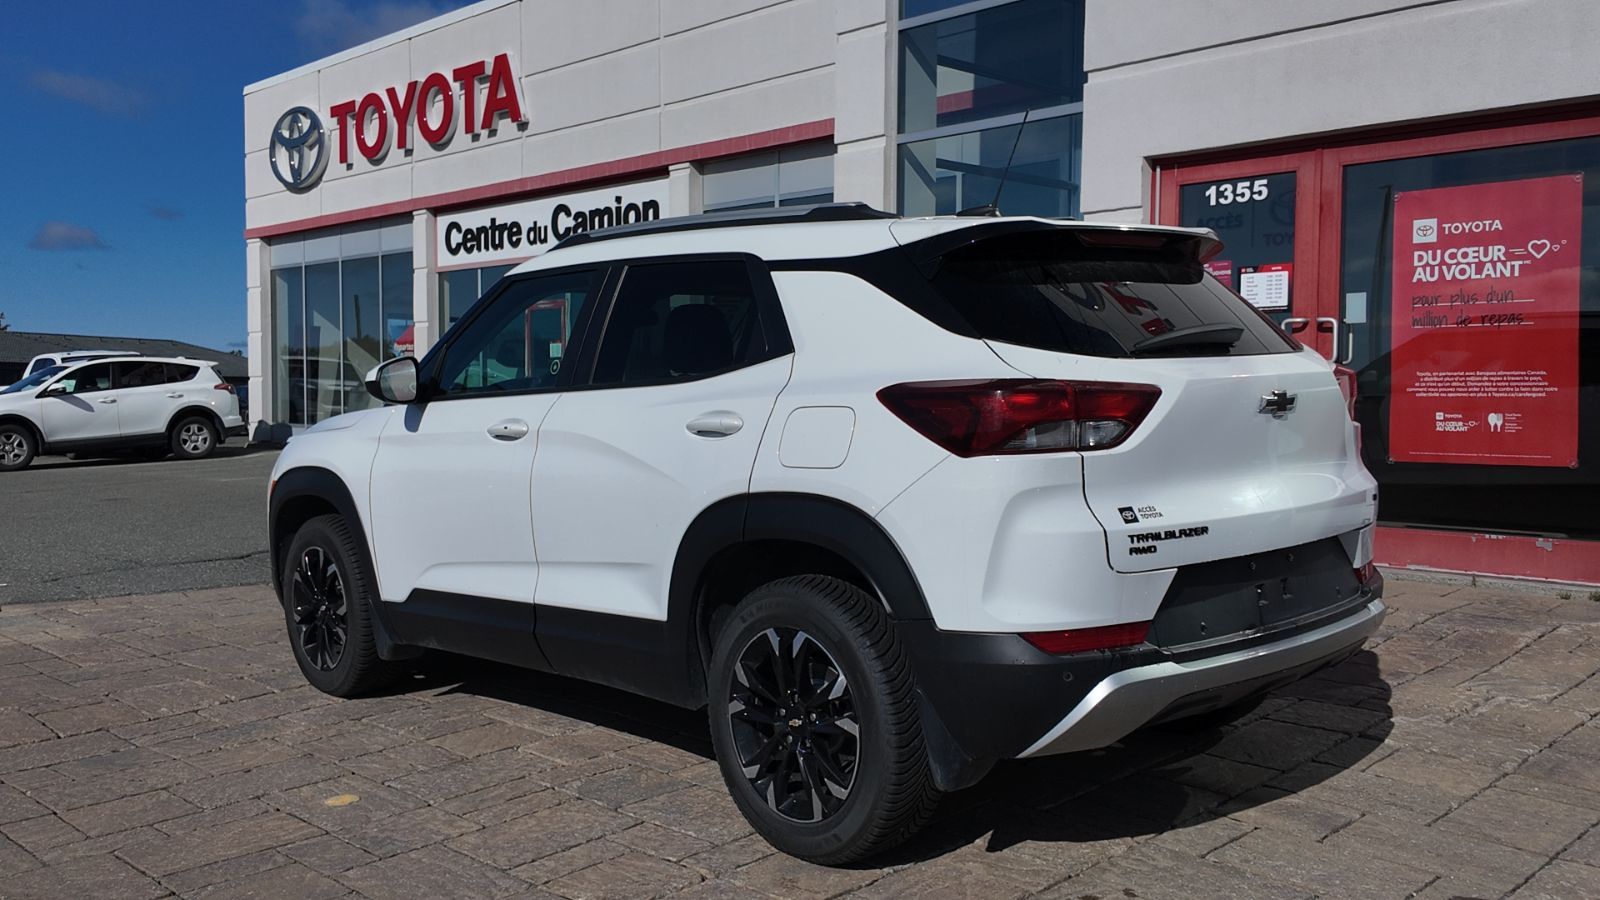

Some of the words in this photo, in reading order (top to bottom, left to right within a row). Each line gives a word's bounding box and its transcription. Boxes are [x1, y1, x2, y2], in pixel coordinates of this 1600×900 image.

[330, 53, 524, 165] TOYOTA
[1205, 179, 1268, 206] 1355
[445, 217, 522, 256] Centre
[527, 220, 548, 246] du
[551, 196, 660, 242] Camion
[1442, 220, 1503, 235] TOYOTA
[1413, 249, 1441, 267] DU
[1444, 245, 1506, 264] CŒUR
[1412, 265, 1441, 283] AU
[1441, 260, 1523, 281] VOLANT
[1412, 295, 1441, 311] pour
[1450, 288, 1478, 309] plus
[1486, 285, 1514, 304] d'un
[1412, 310, 1448, 327] million
[1455, 309, 1472, 326] de
[1480, 312, 1525, 329] repas
[1140, 511, 1163, 519] TOYOTA
[1128, 526, 1209, 544] TRAILBLAZER
[1129, 545, 1157, 556] AWD
